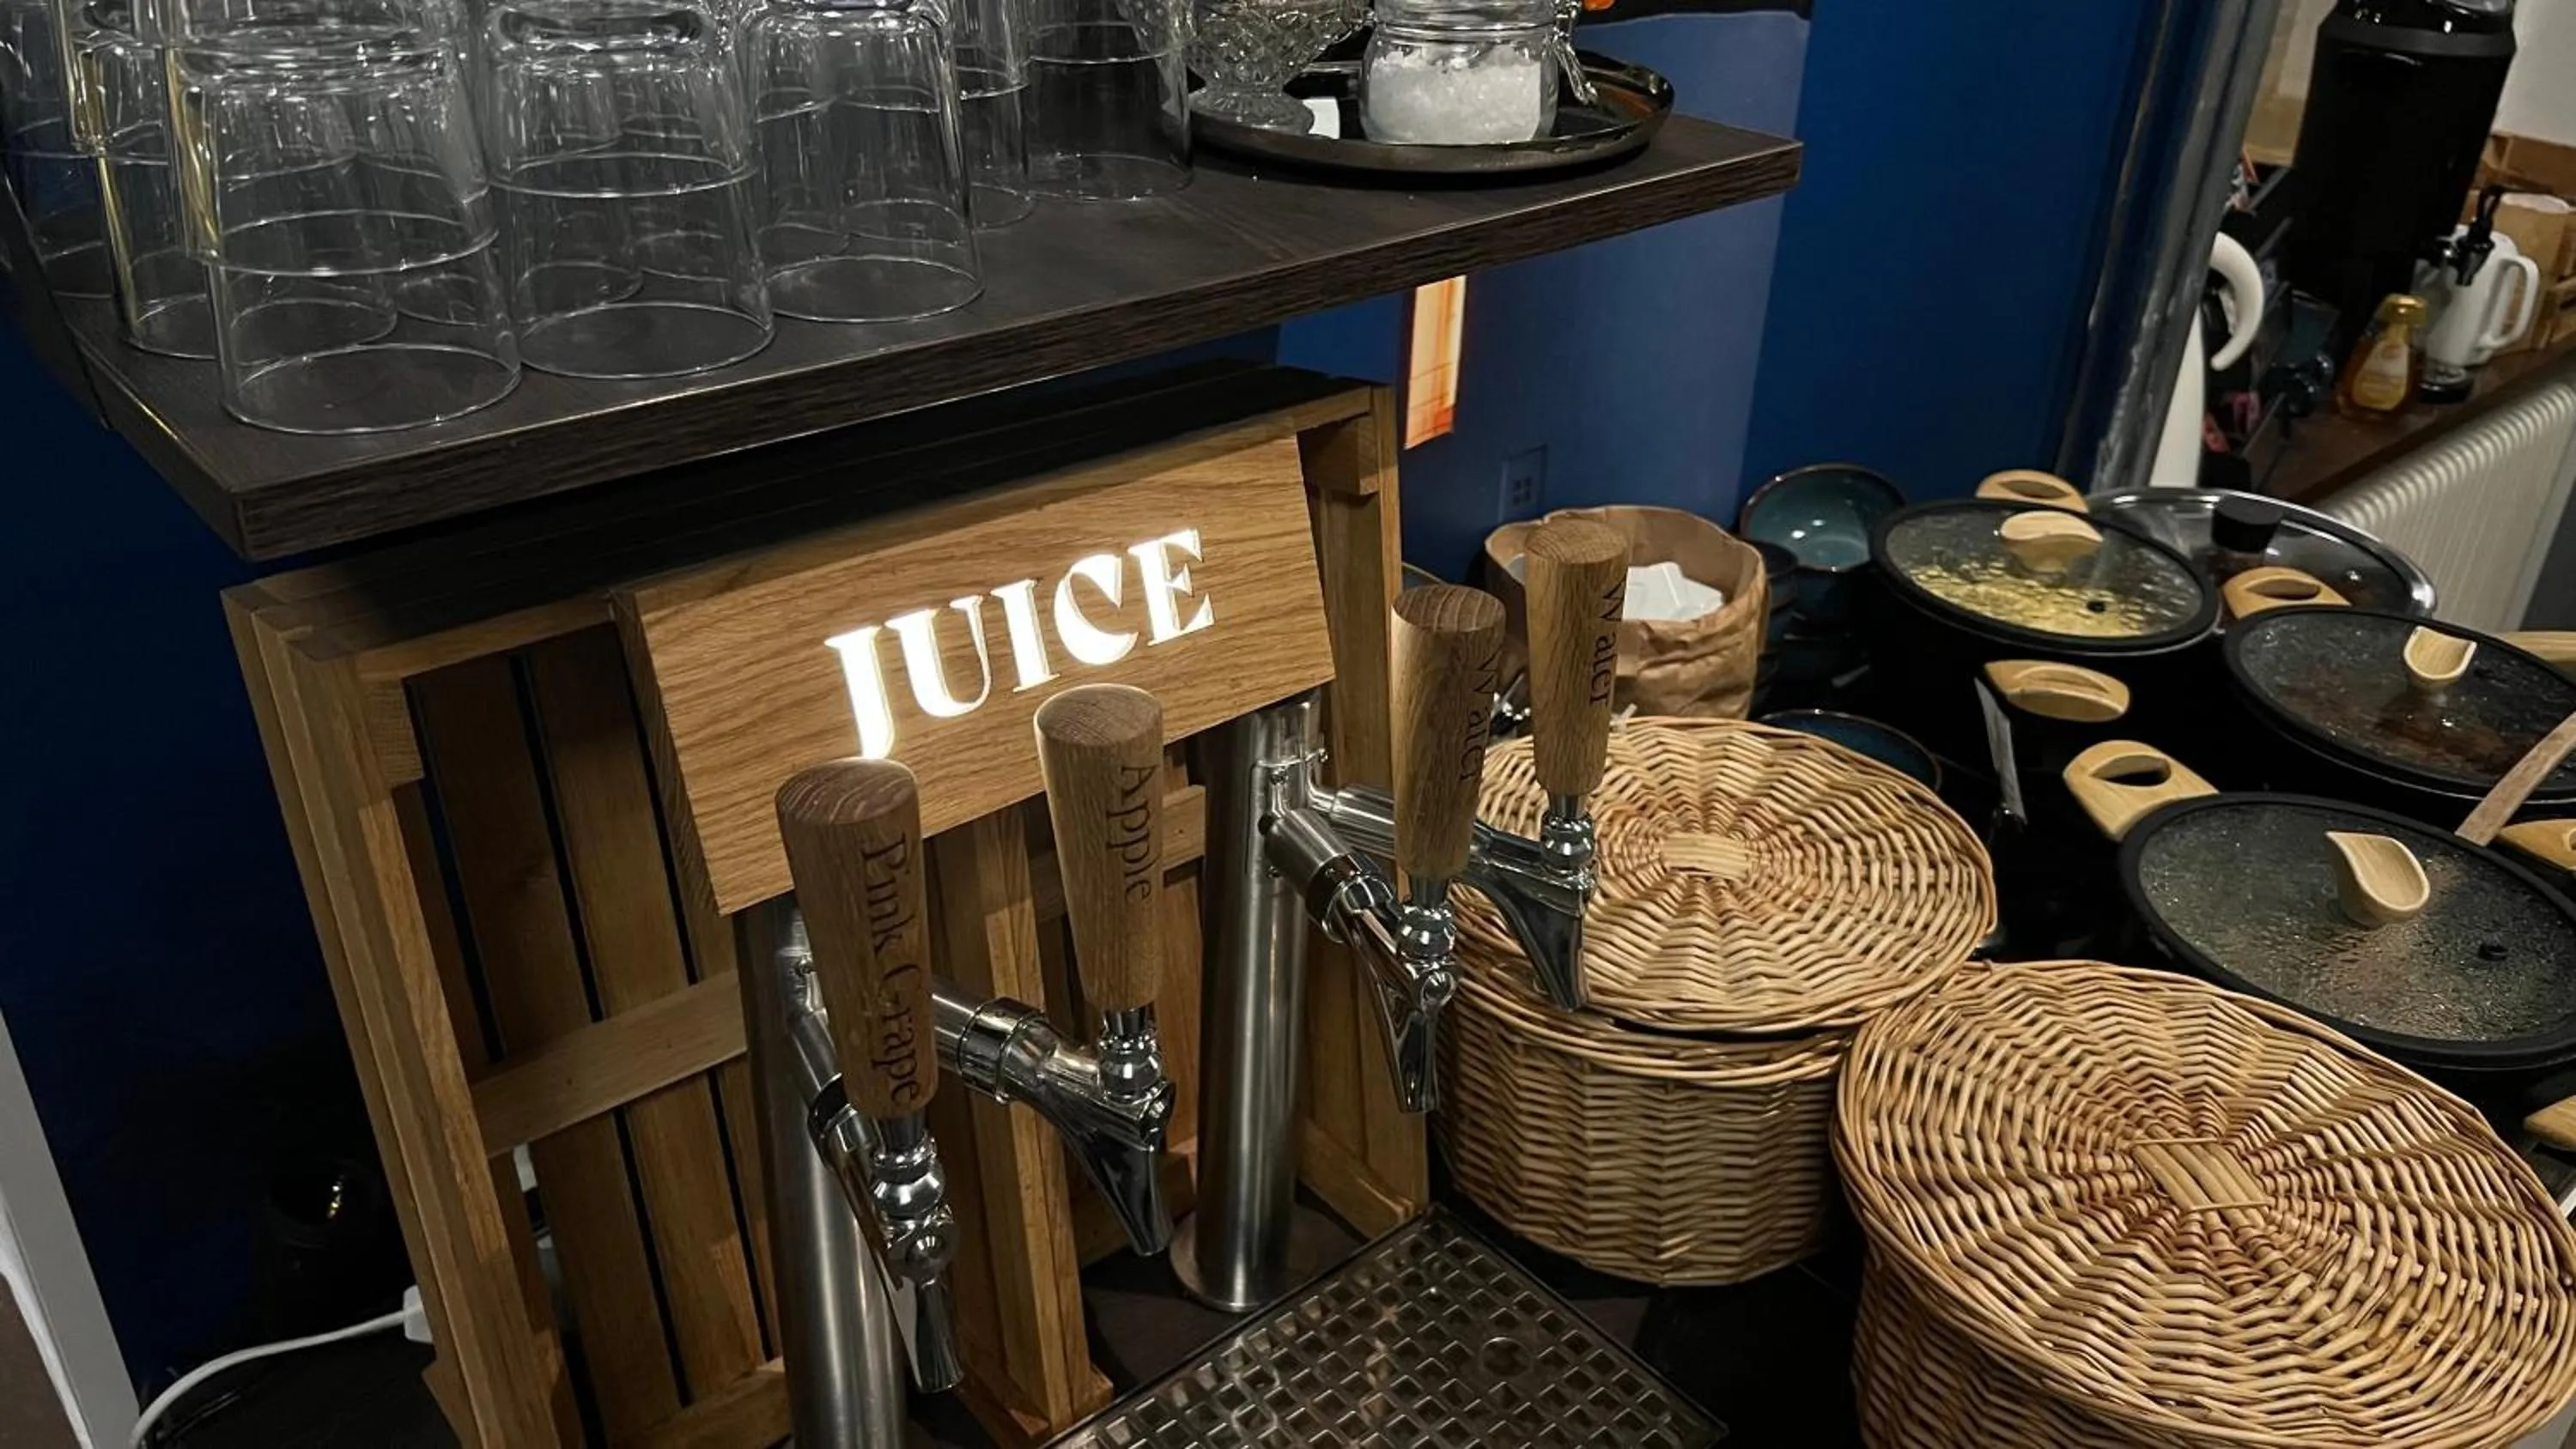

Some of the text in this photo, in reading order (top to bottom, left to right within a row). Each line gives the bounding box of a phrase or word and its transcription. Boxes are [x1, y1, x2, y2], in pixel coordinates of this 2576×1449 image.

[824, 528, 1216, 759] JUICE
[1589, 578, 1626, 706] Water
[1460, 645, 1503, 780] Water
[1106, 765, 1157, 904] Apple
[862, 832, 921, 1102] Pink Grape
